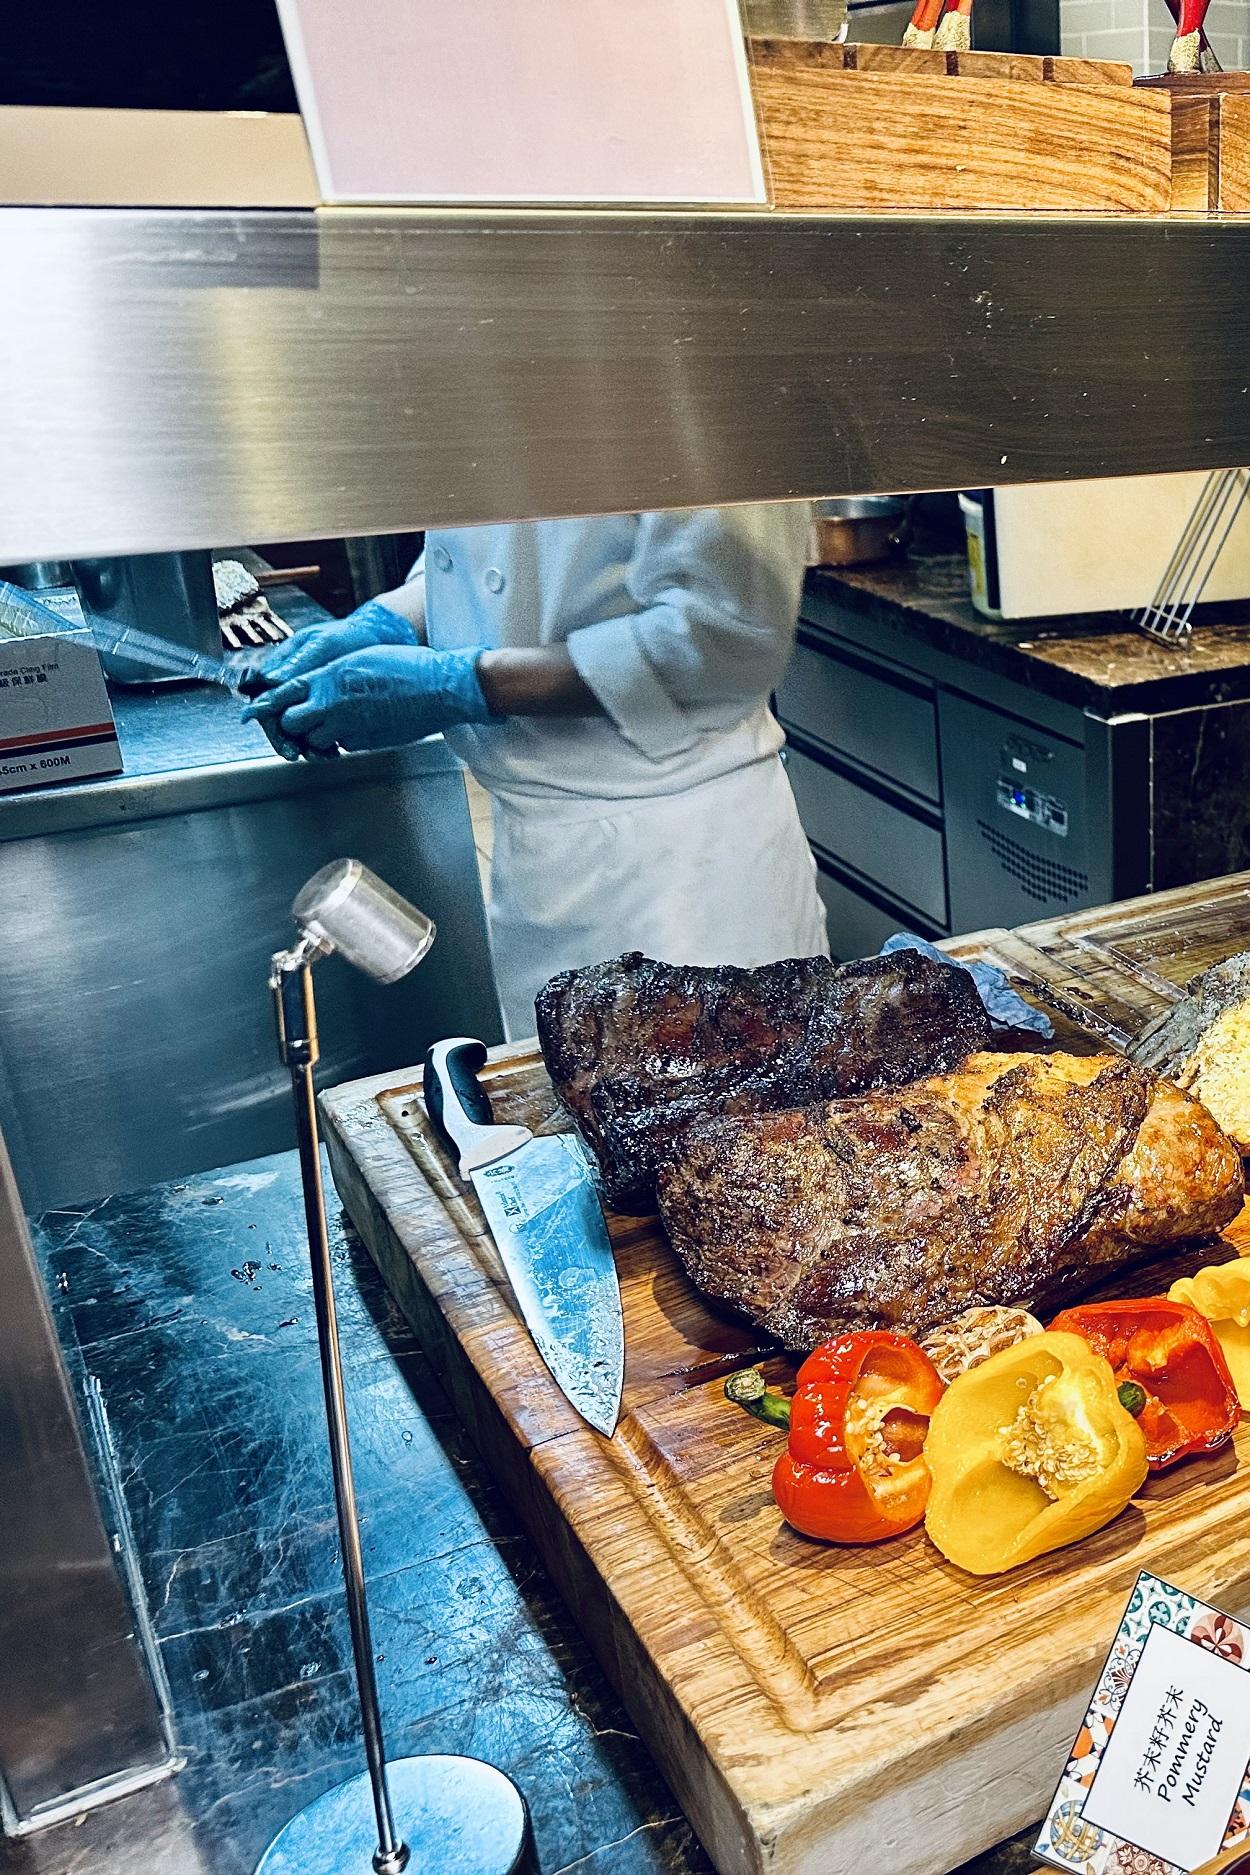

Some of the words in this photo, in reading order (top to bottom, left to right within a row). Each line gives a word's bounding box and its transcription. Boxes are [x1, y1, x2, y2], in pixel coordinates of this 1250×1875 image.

[40, 755, 71, 769] 600M
[1133, 1685, 1185, 1794] 芥末籽芥末
[1157, 1698, 1209, 1803] Pommery
[1181, 1713, 1224, 1808] Mustard
